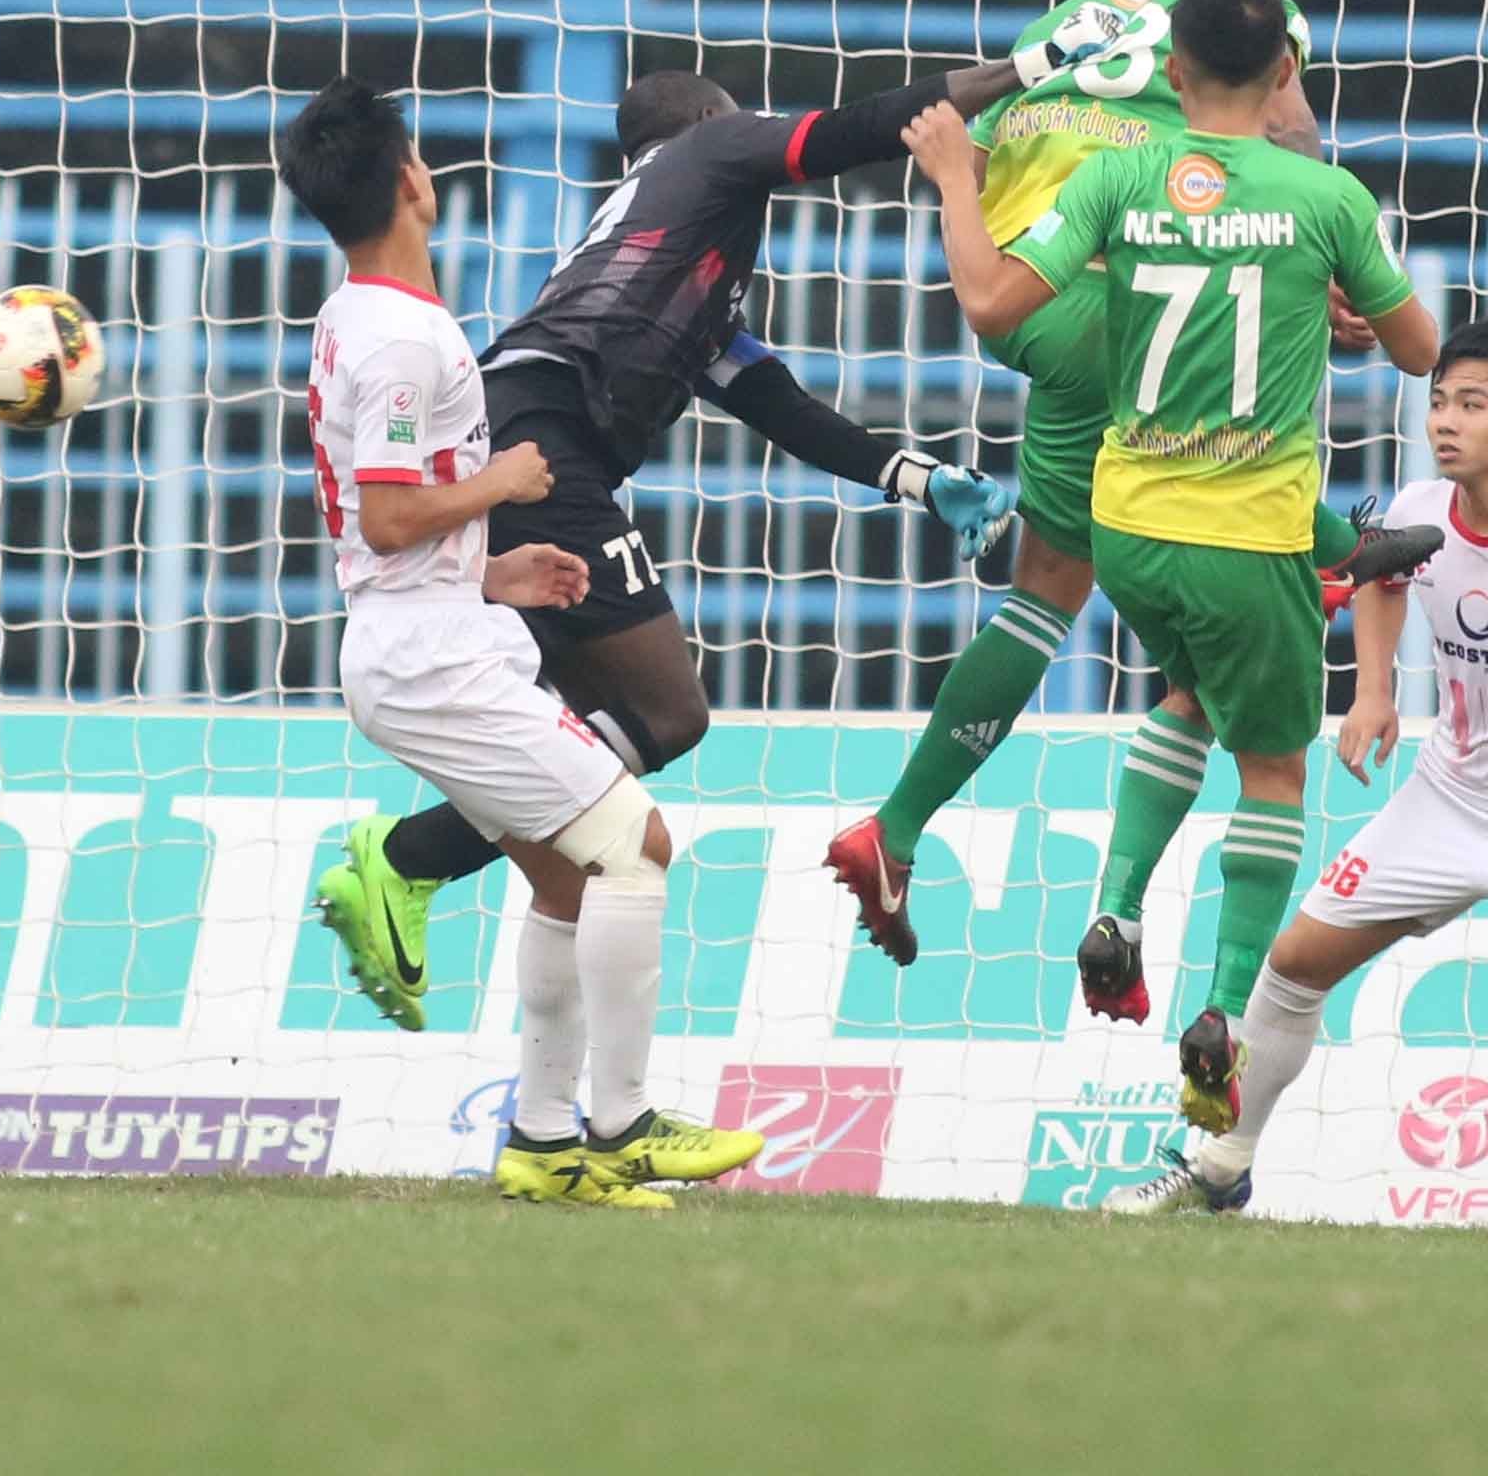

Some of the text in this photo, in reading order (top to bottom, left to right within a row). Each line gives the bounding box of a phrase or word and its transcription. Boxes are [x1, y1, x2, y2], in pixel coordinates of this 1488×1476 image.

[1123, 207, 1295, 247] N.C. THÀNH
[1132, 264, 1263, 419] 71
[48, 1110, 329, 1163] TUYLIPS
[1030, 1118, 1204, 1173] NU
